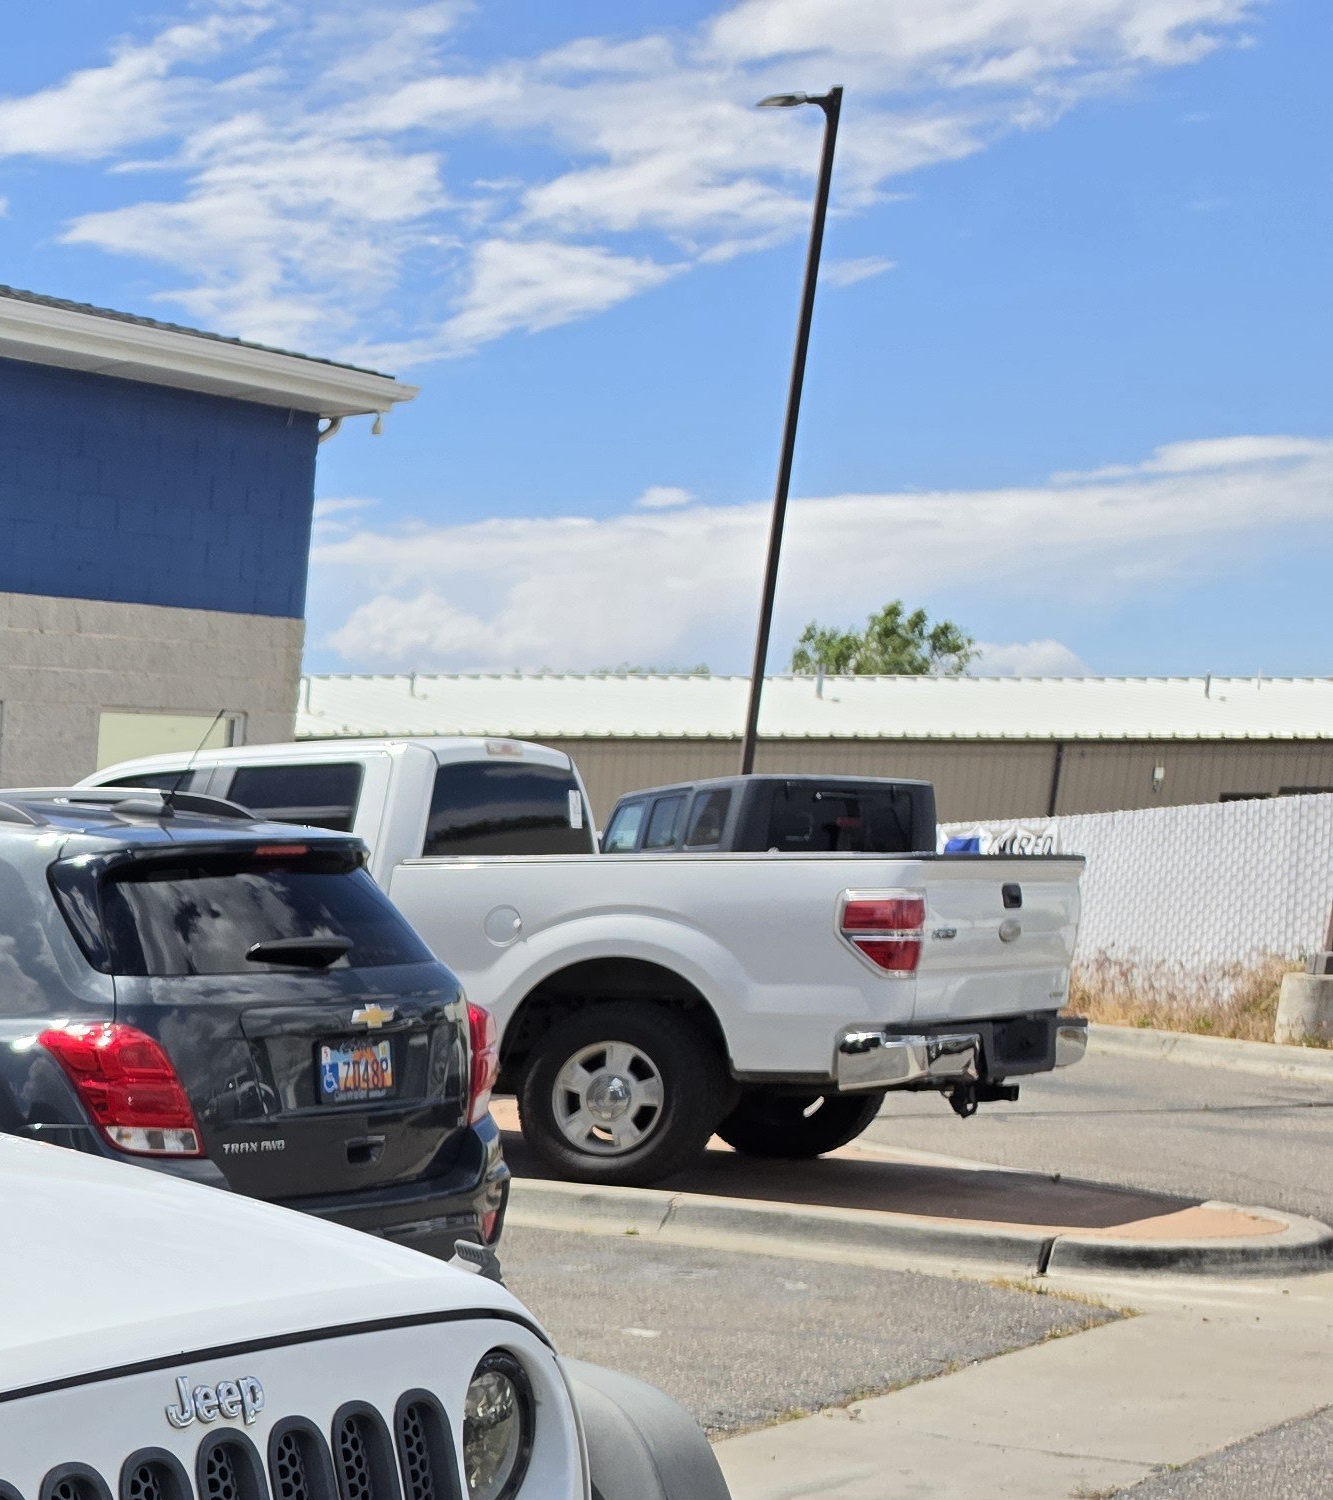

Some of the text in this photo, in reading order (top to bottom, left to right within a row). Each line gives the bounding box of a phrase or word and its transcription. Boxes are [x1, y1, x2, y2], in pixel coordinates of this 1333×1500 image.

[223, 1139, 285, 1154] TRAX AWD
[166, 1376, 265, 1428] Jeep
